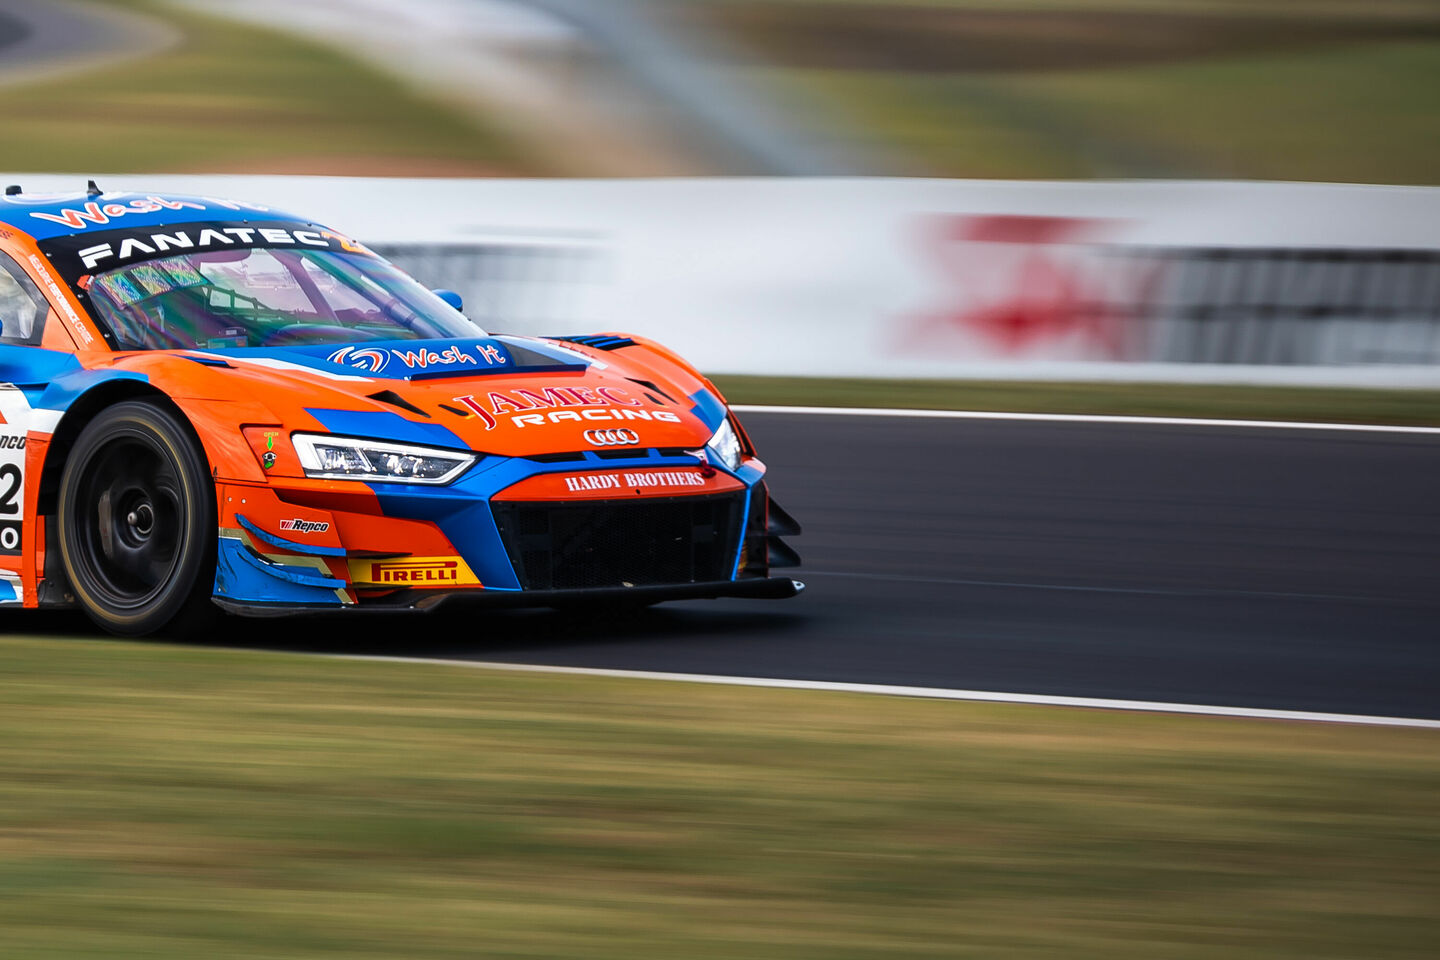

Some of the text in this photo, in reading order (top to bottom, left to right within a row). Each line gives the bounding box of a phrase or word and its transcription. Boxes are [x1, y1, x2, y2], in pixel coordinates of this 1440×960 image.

[29, 194, 207, 230] Wash
[78, 227, 331, 270] FANATEC
[392, 344, 507, 368] Wash It
[452, 386, 644, 431] JAMEC
[510, 408, 682, 428] RACING
[564, 471, 706, 492] HARDY BROTHERS
[293, 518, 330, 533] Repco
[371, 561, 458, 582] PIRELLI
